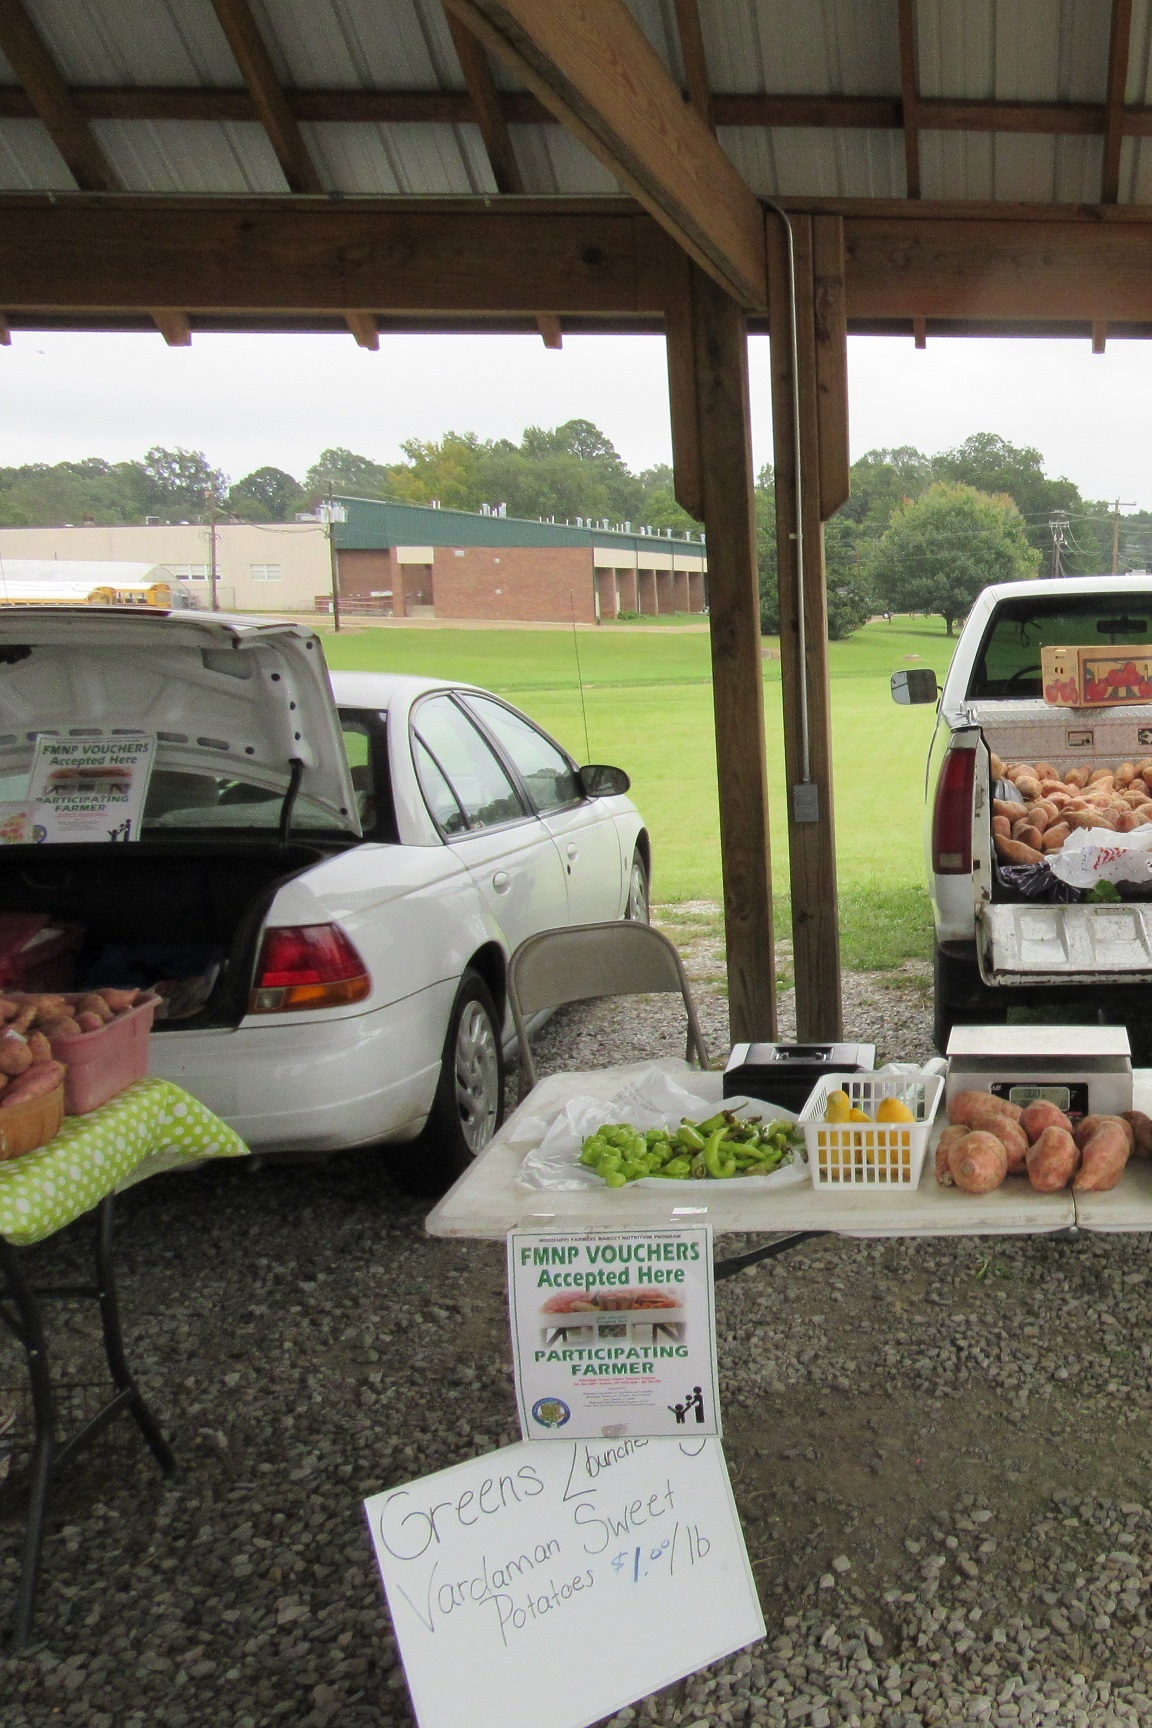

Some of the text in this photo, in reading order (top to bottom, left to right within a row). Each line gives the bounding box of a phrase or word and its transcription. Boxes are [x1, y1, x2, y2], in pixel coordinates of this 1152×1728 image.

[42, 743, 149, 755] FMNP VOUCHERS
[50, 755, 138, 768] Accepted Here
[36, 795, 129, 804] PARTICIPATING
[55, 804, 107, 812] FARMER
[520, 1241, 700, 1266] FMNP VOUCHERS
[537, 1265, 685, 1291] Accepted Here
[534, 1345, 689, 1362] PARTICIPATING
[571, 1362, 654, 1376] FARMER
[379, 1465, 544, 1560] Greens
[396, 1479, 675, 1633] Vardaman Sweet
[479, 1568, 594, 1647] Potatoes
